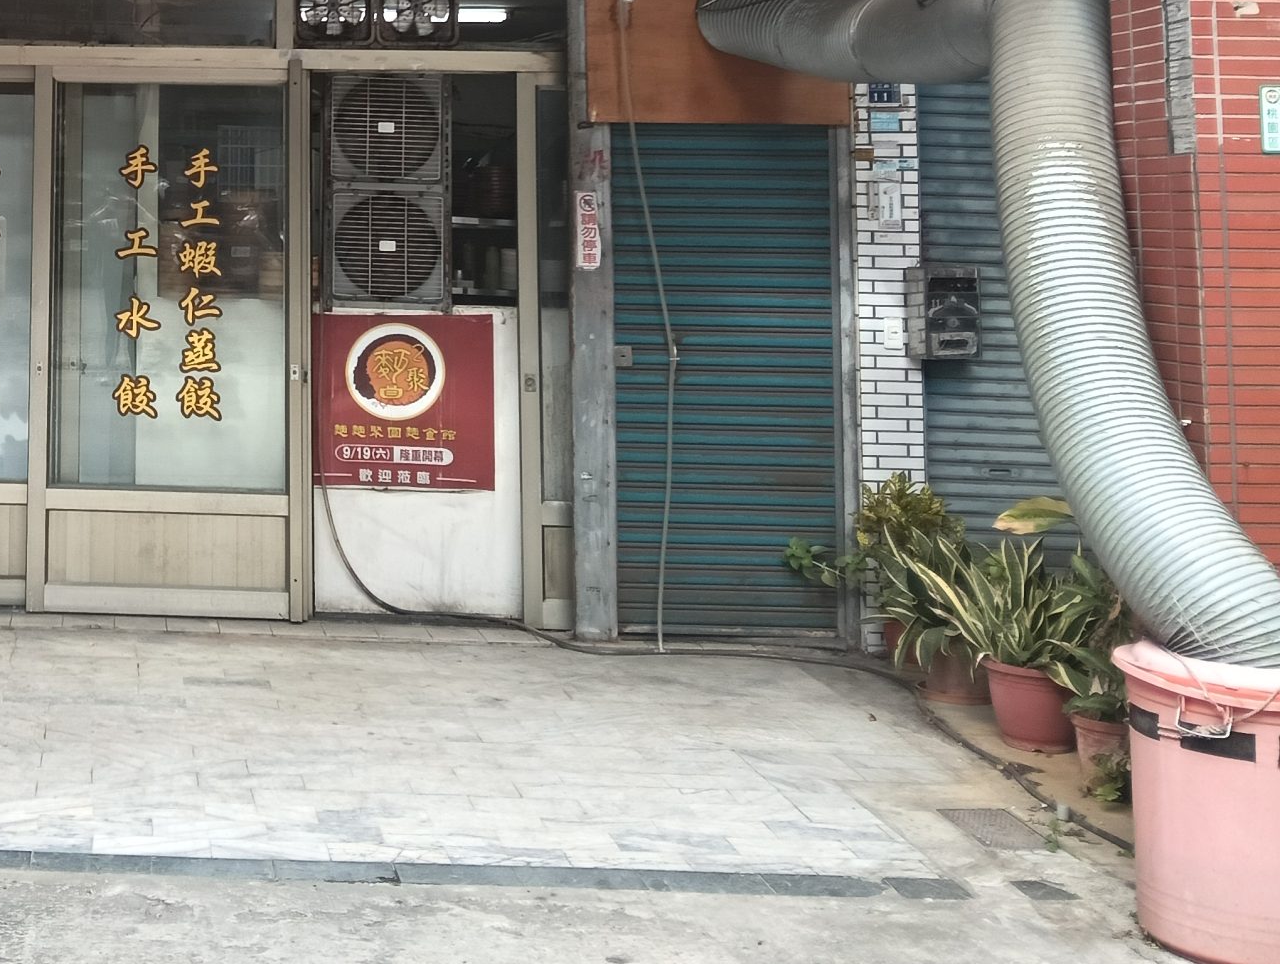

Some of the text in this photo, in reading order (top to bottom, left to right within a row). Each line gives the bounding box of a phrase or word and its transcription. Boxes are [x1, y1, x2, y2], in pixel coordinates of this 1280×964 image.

[114, 144, 160, 419] 手工水餃
[177, 148, 223, 421] 手工蝦仁蒸餃
[358, 468, 431, 485] 歡迎蒞臨
